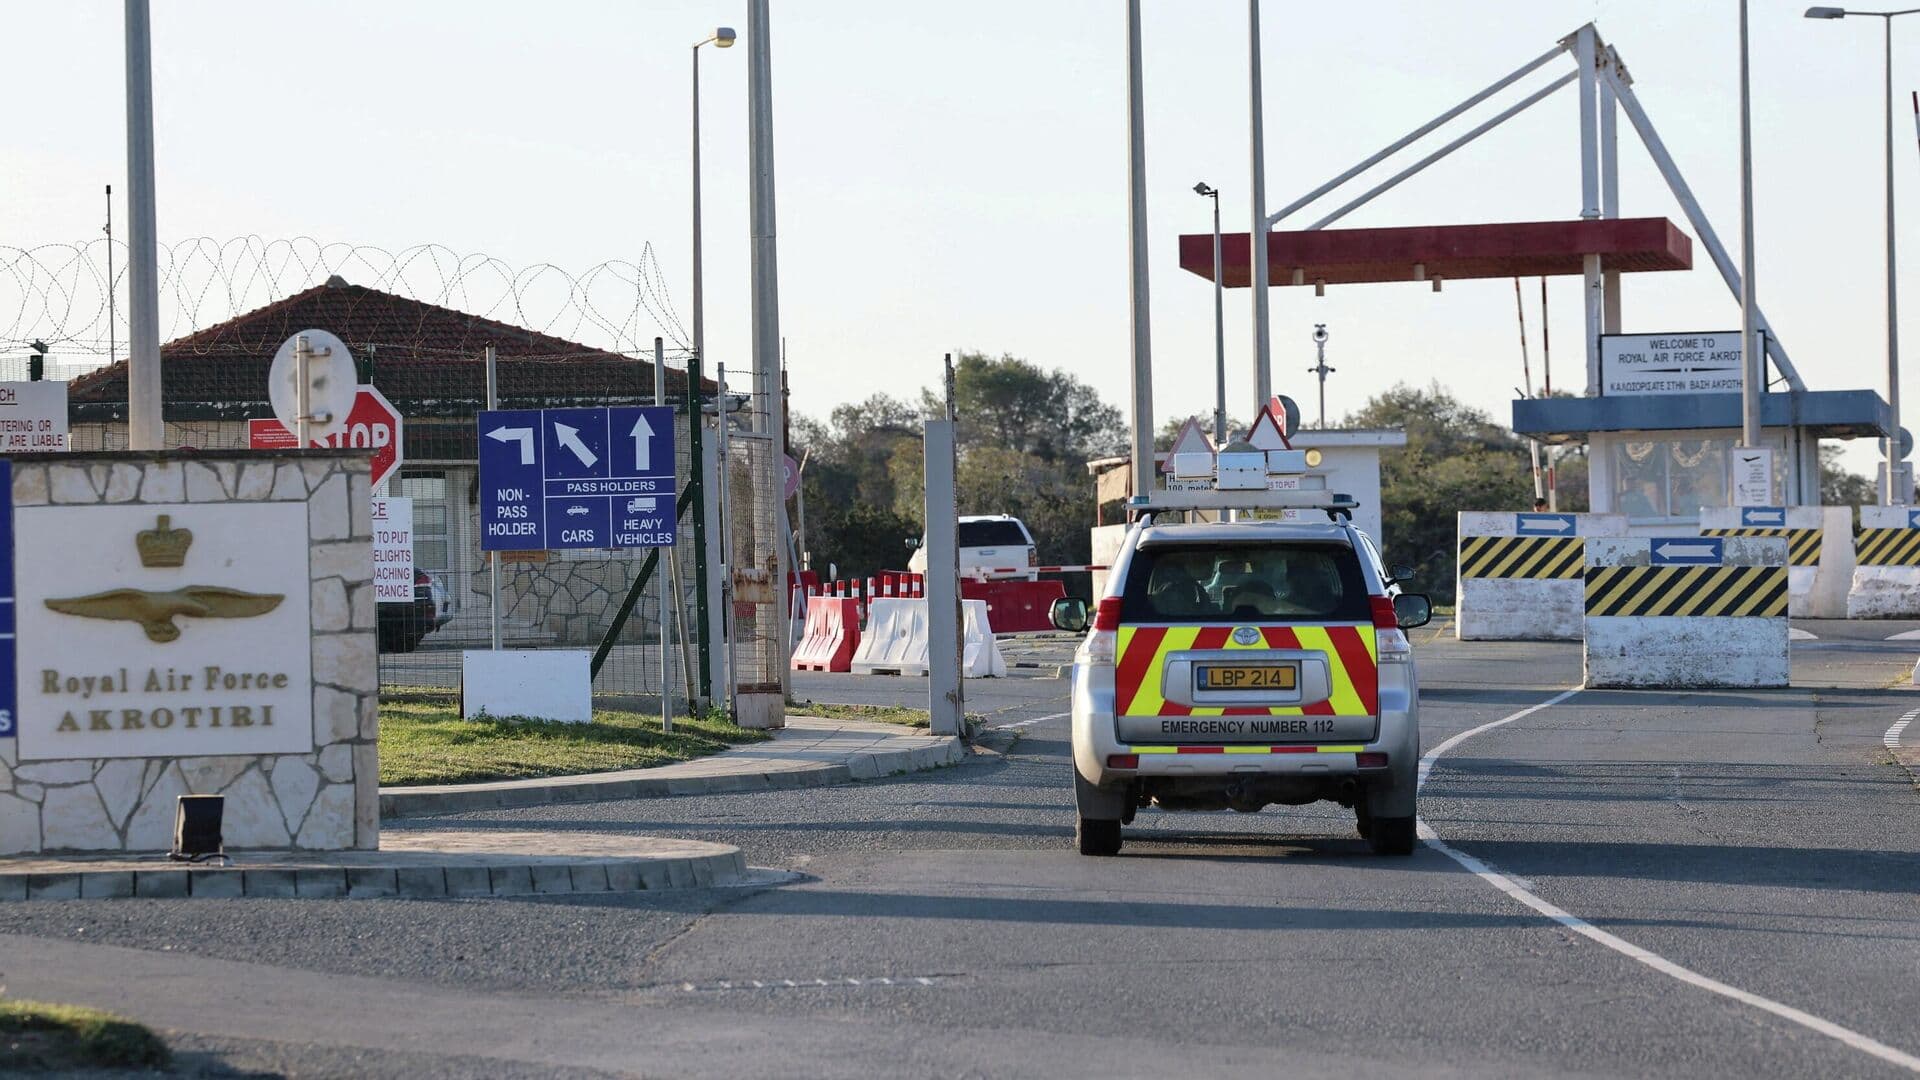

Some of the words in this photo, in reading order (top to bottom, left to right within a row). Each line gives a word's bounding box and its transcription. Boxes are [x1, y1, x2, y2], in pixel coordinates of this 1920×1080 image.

[1650, 339, 1698, 350] WELCOME
[1702, 338, 1715, 348] TO
[1618, 353, 1648, 364] ROYAL
[1653, 352, 1669, 362] AIR
[1674, 351, 1705, 362] FORCE
[39, 420, 51, 431] OR
[9, 434, 26, 446] ARE
[32, 434, 63, 446] LIABLE
[567, 483, 597, 493] PASS
[600, 481, 656, 492] HOLDERS
[1275, 481, 1283, 489] TO
[1284, 480, 1296, 489] PUT
[497, 489, 522, 501] NON
[497, 505, 527, 518] PASS
[488, 522, 536, 536] HOLDER
[623, 518, 663, 530] HEAVY
[377, 531, 389, 543] TO
[391, 531, 408, 543] PUT
[561, 529, 594, 543] CARS
[615, 533, 672, 545] VEHICLES
[373, 567, 410, 580] ACHING
[41, 668, 128, 699] Royal
[144, 668, 193, 692] Air
[204, 666, 289, 691] Force
[1210, 670, 1245, 686] LBP
[1251, 670, 1281, 686] 214
[56, 705, 274, 732] AKROTIRI
[1161, 720, 1245, 734] EMERGENCY
[1251, 720, 1307, 733] NUMBER
[1313, 720, 1334, 733] 112
